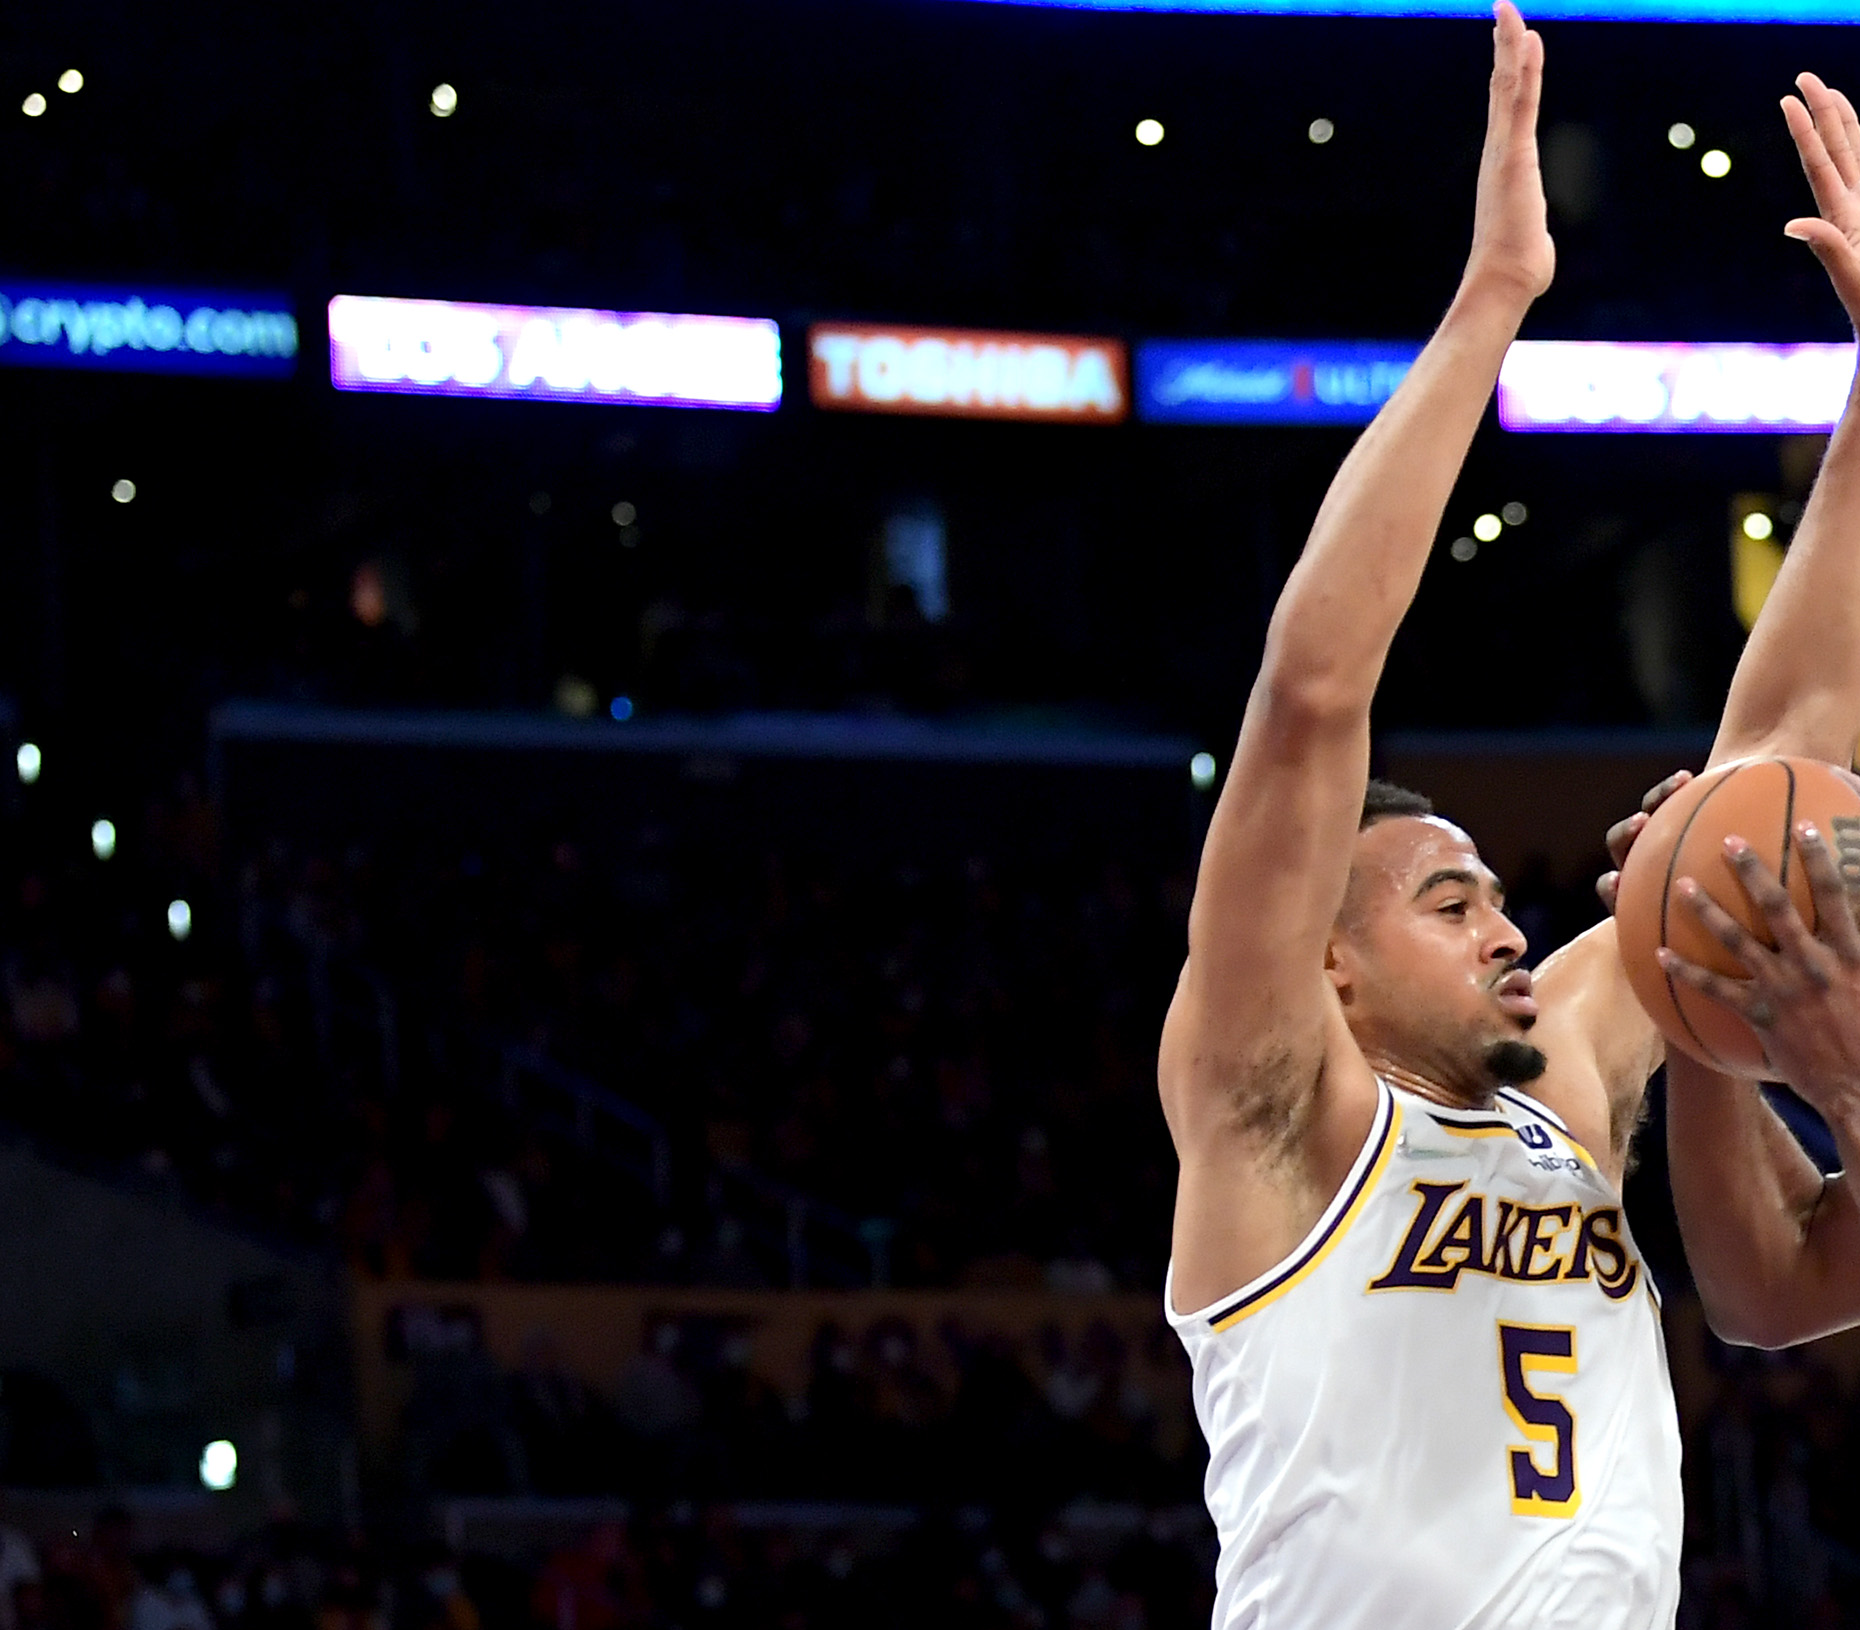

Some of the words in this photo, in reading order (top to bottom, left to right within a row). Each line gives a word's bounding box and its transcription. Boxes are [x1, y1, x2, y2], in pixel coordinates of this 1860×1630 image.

[8, 297, 298, 357] crypto.com
[811, 334, 1123, 414] TOSHIBA
[1496, 1319, 1582, 1519] 5
